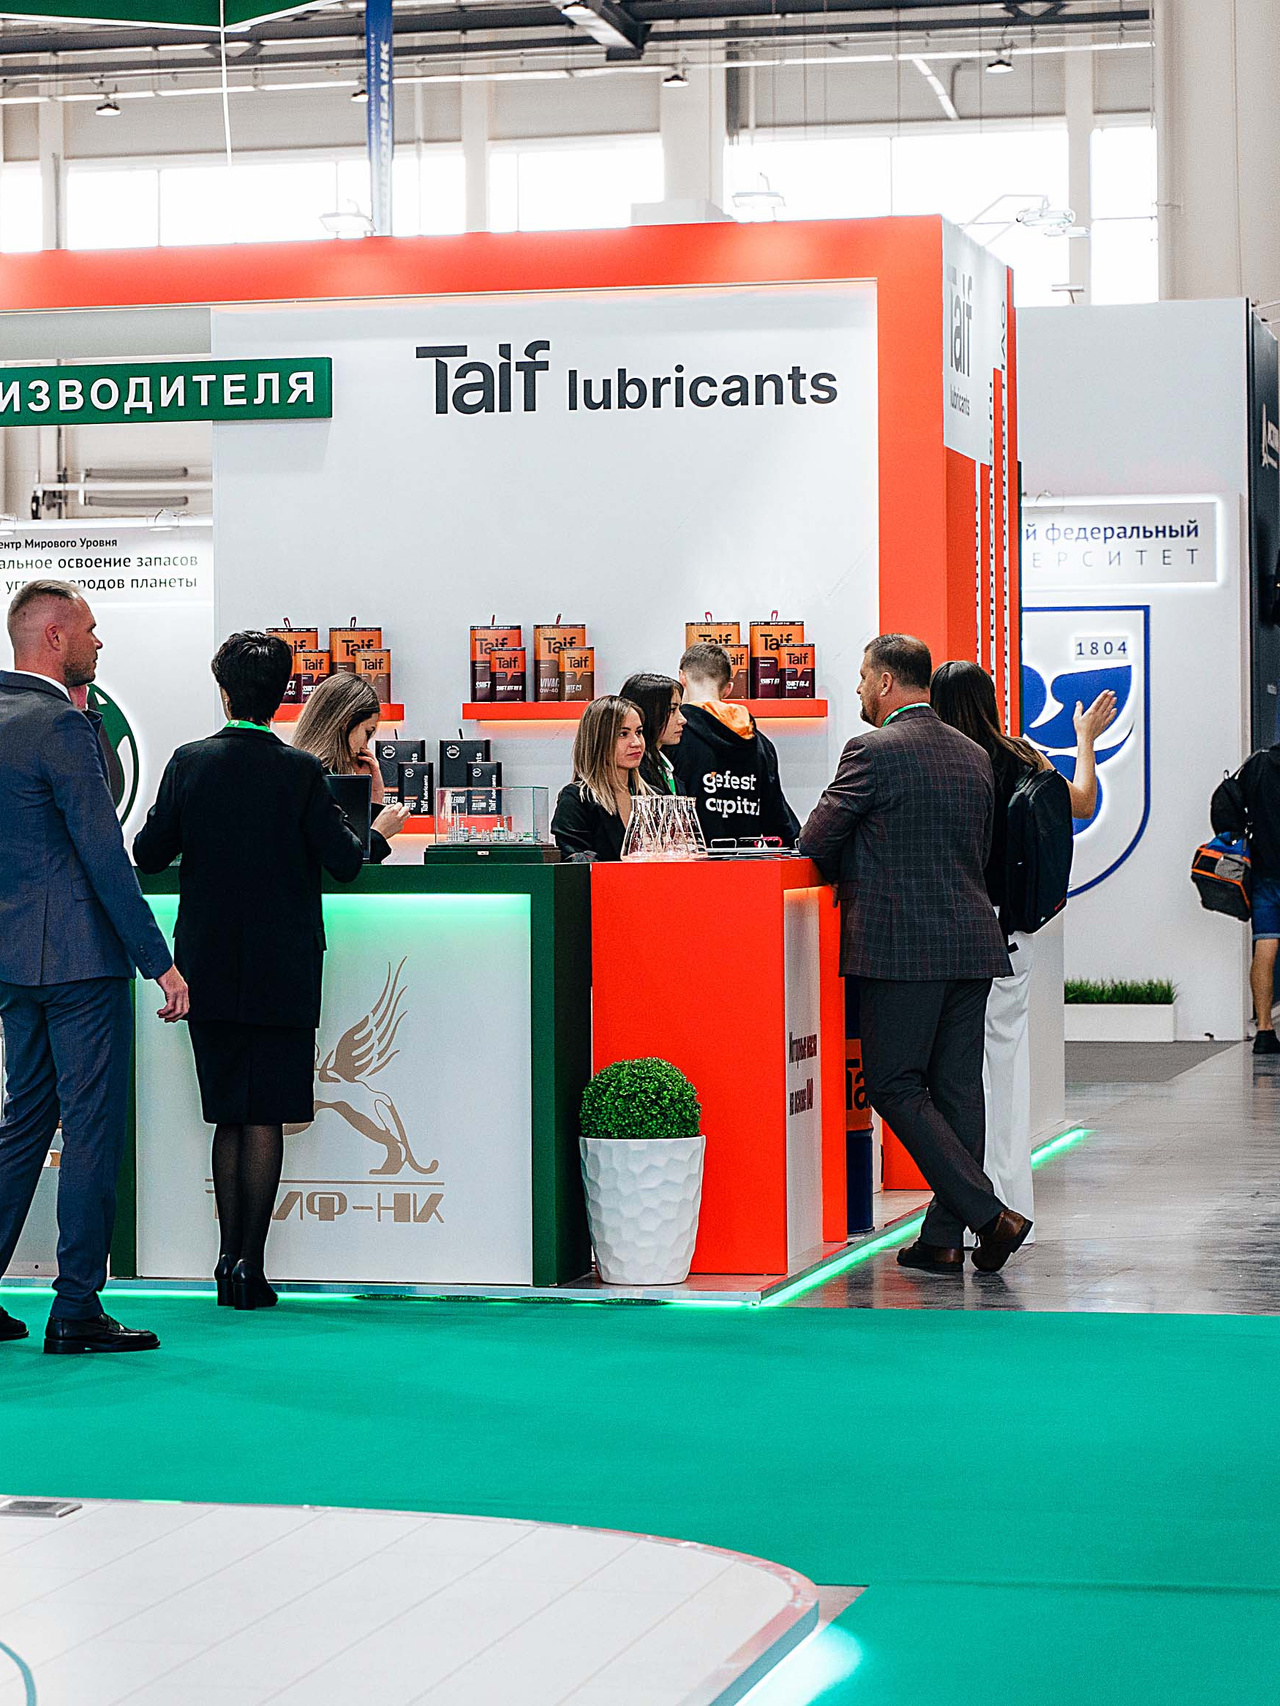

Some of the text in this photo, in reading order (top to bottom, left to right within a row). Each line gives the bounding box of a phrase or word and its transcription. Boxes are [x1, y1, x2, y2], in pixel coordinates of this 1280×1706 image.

[415, 339, 838, 417] Taif lubricants
[1045, 520, 1199, 544] федеральный
[24, 538, 77, 550] Мирового
[79, 537, 118, 549] Уровня
[58, 554, 131, 568] освоение
[136, 554, 198, 567] запасов
[130, 576, 197, 590] планеты
[1076, 641, 1127, 656] 1804
[302, 658, 324, 671] Taif
[361, 658, 384, 671] Taif
[495, 656, 519, 669] Taif
[567, 656, 590, 669] Taif
[731, 654, 744, 666] aif
[786, 653, 809, 665] Taif
[702, 770, 757, 794] gefest
[250, 1190, 444, 1223] ИФ-НК
